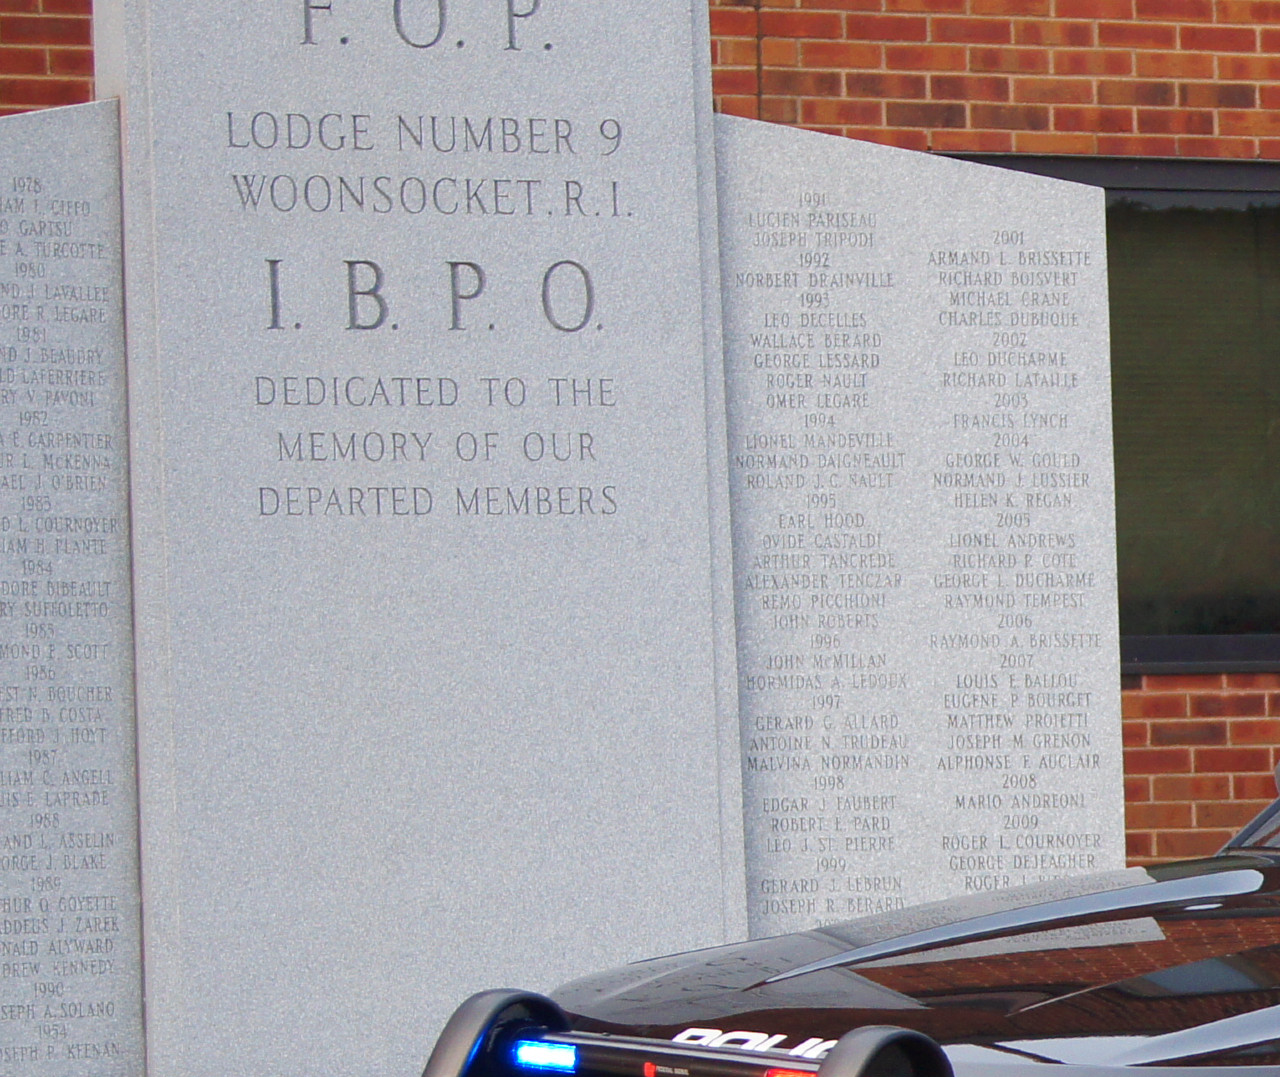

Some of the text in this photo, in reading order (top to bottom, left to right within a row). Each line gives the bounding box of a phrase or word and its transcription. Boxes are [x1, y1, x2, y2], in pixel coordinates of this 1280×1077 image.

[227, 112, 622, 155] LODGE NUMBER 9
[265, 259, 603, 332] I. B. P. O.
[255, 377, 617, 406] DEDICATED TO THE
[278, 432, 596, 462] MEMORY OF OUR
[259, 486, 618, 517] DEPARTED MEMBERS
